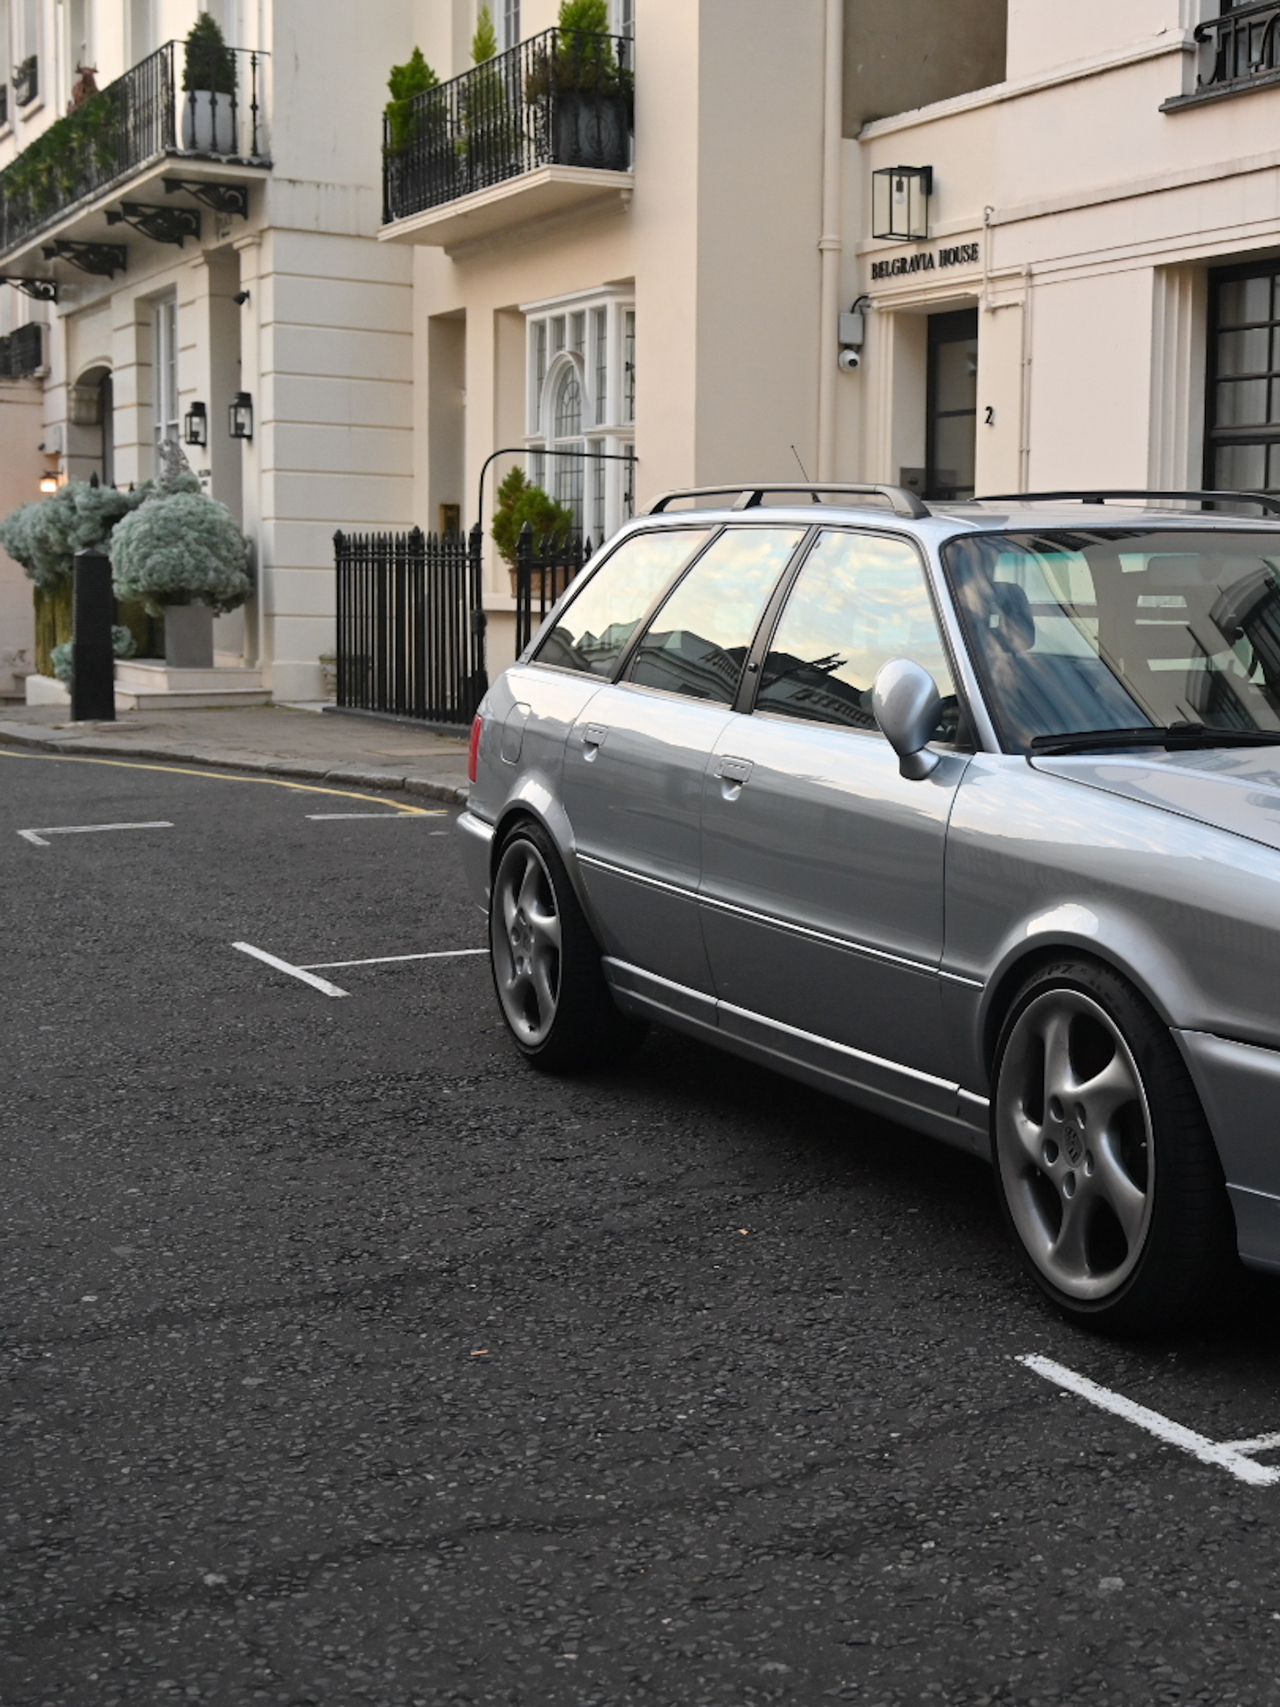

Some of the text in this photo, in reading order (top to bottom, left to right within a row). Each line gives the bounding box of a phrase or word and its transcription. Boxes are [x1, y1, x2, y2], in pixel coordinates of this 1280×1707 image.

[870, 242, 980, 280] BELGRAVIA HOUSE
[984, 405, 994, 426] 2
